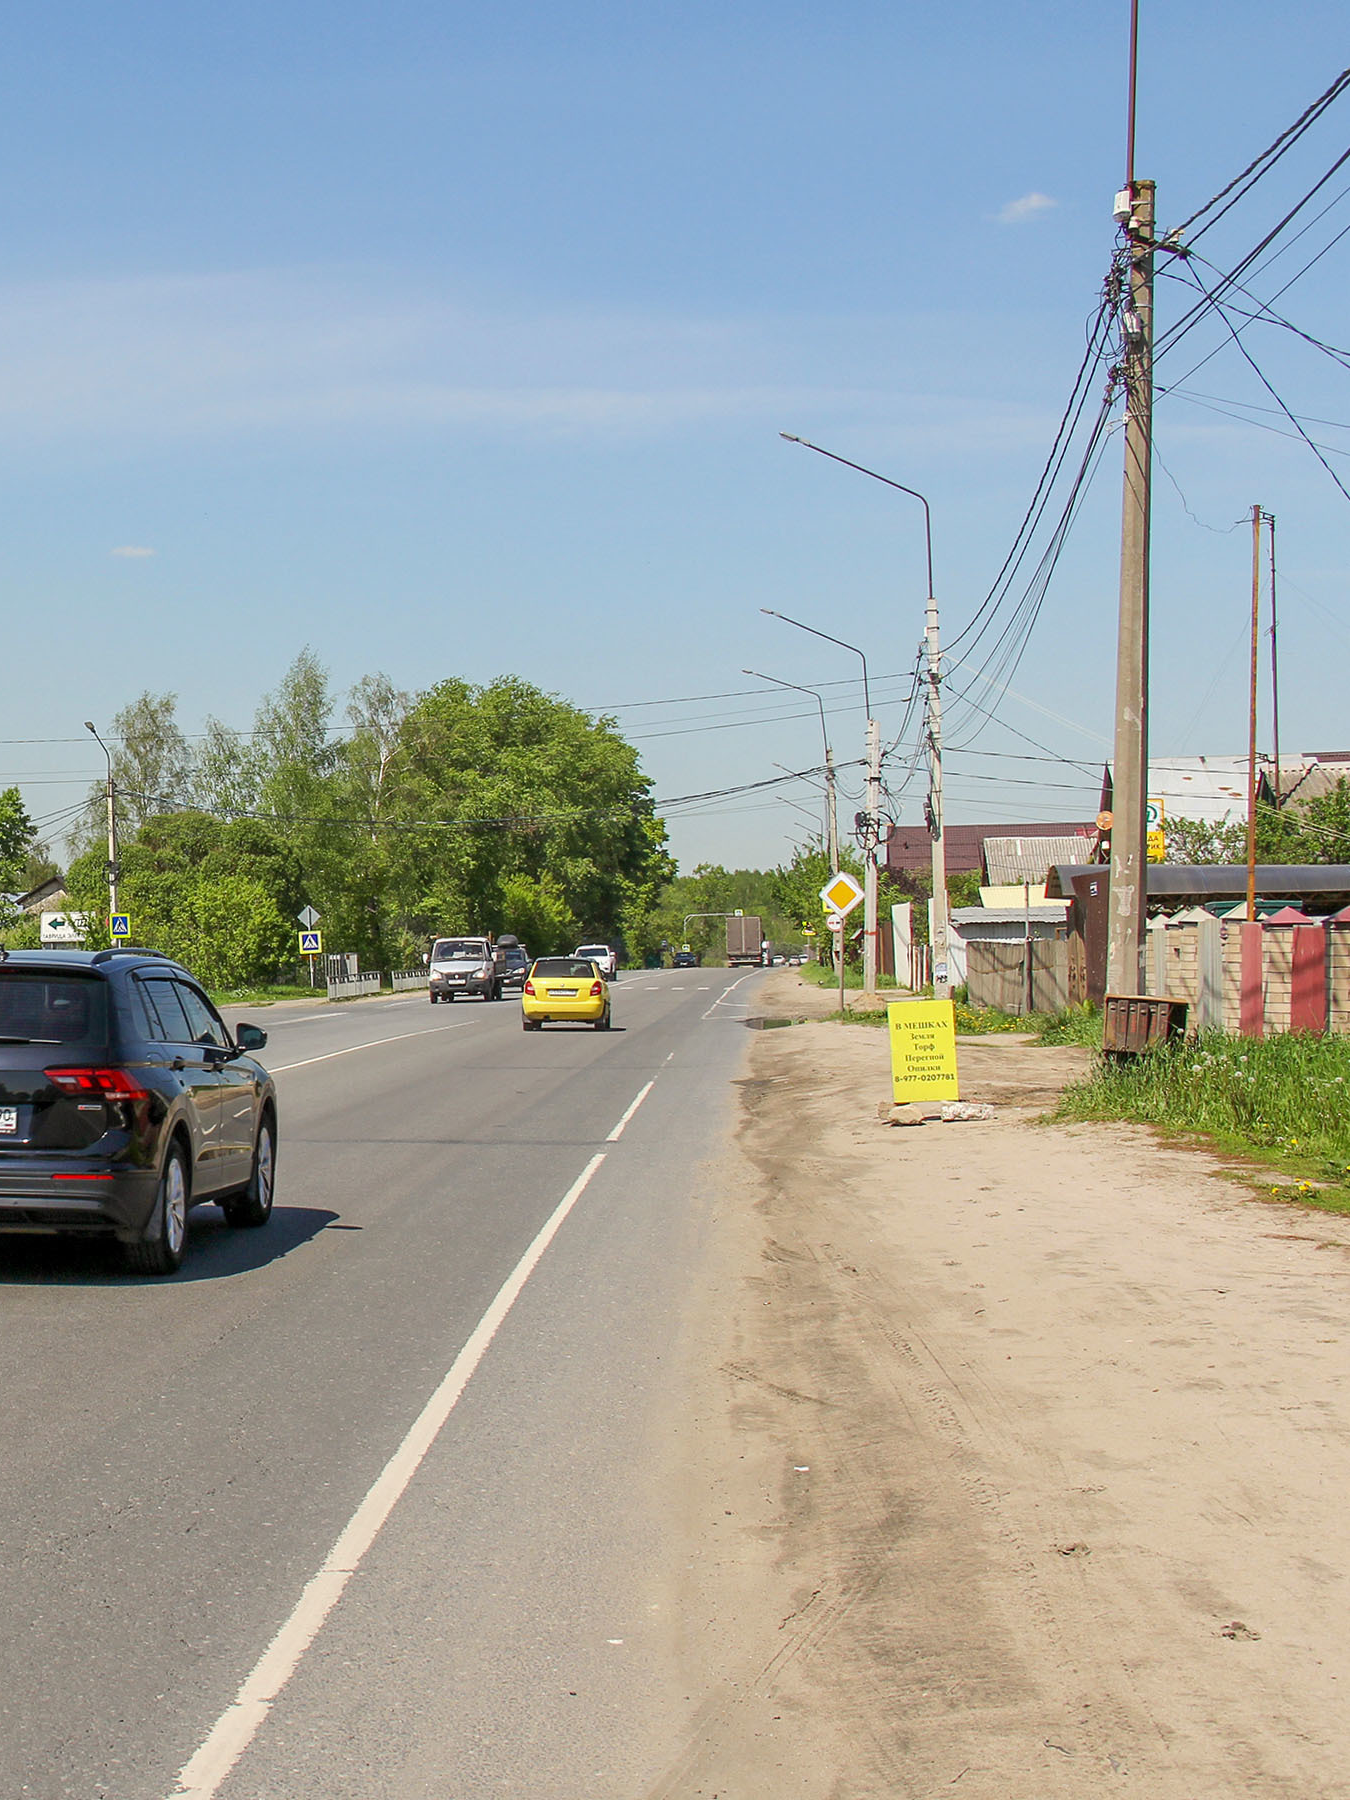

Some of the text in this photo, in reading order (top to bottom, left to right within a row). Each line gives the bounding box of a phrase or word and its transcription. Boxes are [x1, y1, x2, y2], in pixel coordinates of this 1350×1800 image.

[895, 1020, 948, 1031] В МЕШКАХ
[910, 1032, 935, 1041] Земля
[914, 1043, 936, 1052] Торф
[905, 1053, 945, 1063] Перегной
[907, 1064, 941, 1073] Опилки
[894, 1073, 955, 1083] 8-977-0207781
